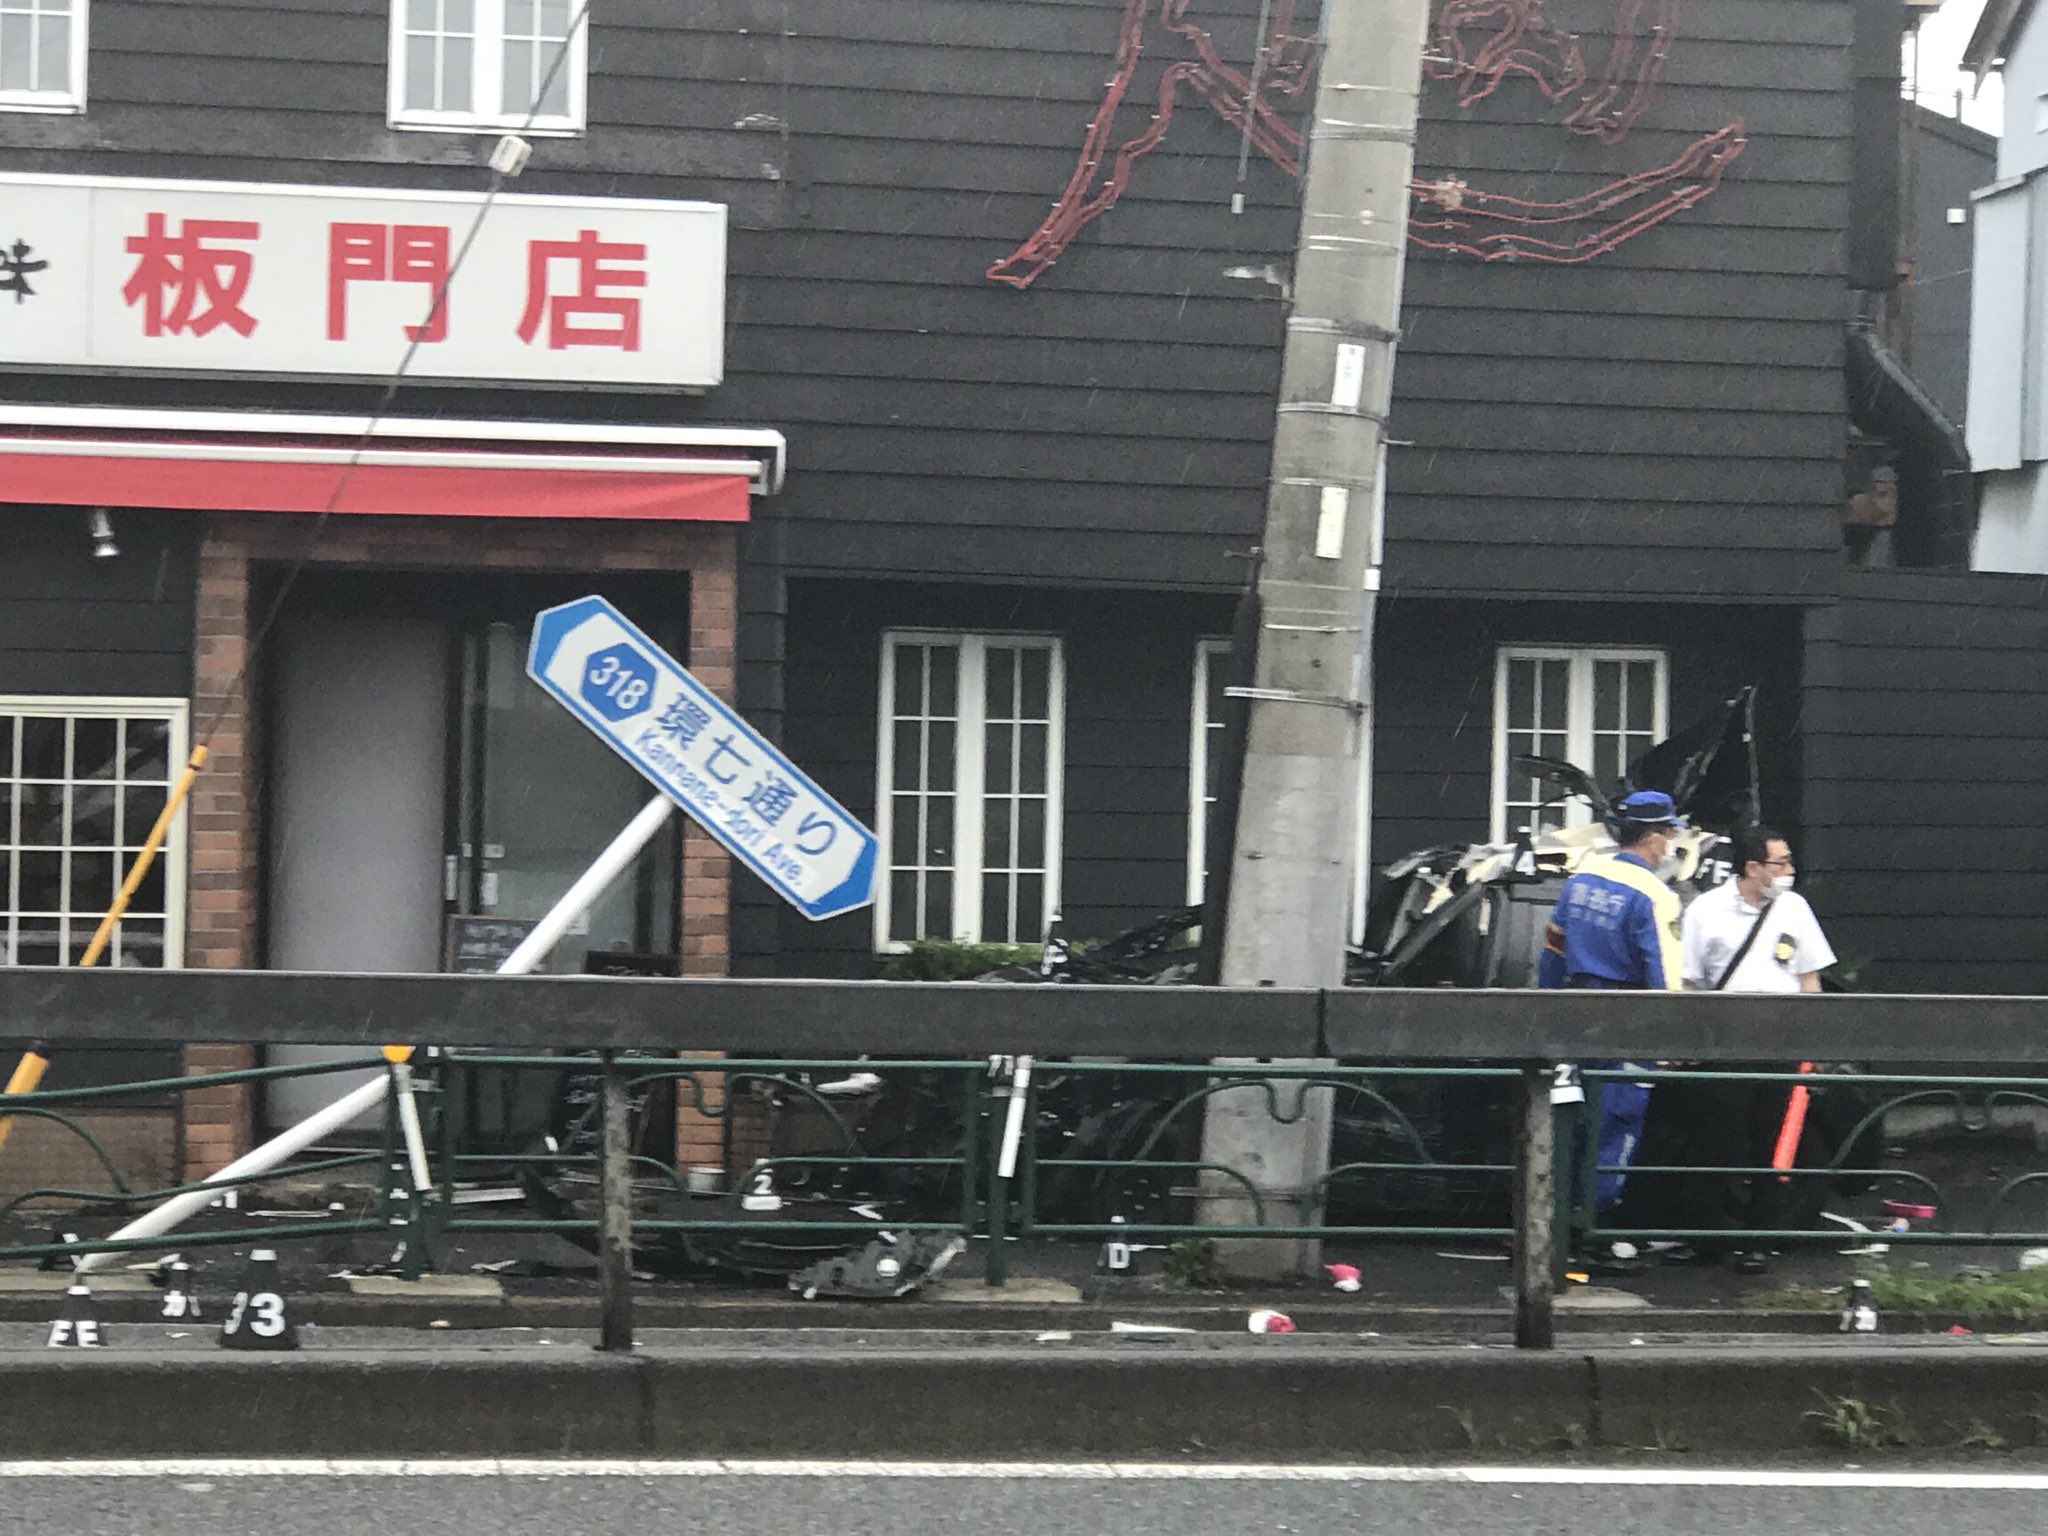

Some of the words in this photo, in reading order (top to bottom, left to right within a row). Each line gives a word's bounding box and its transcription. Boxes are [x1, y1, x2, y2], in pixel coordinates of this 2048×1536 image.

[122, 211, 648, 353] 板門店
[590, 656, 650, 710] 318
[656, 691, 837, 856] 環七通り
[762, 842, 804, 886] Ave.
